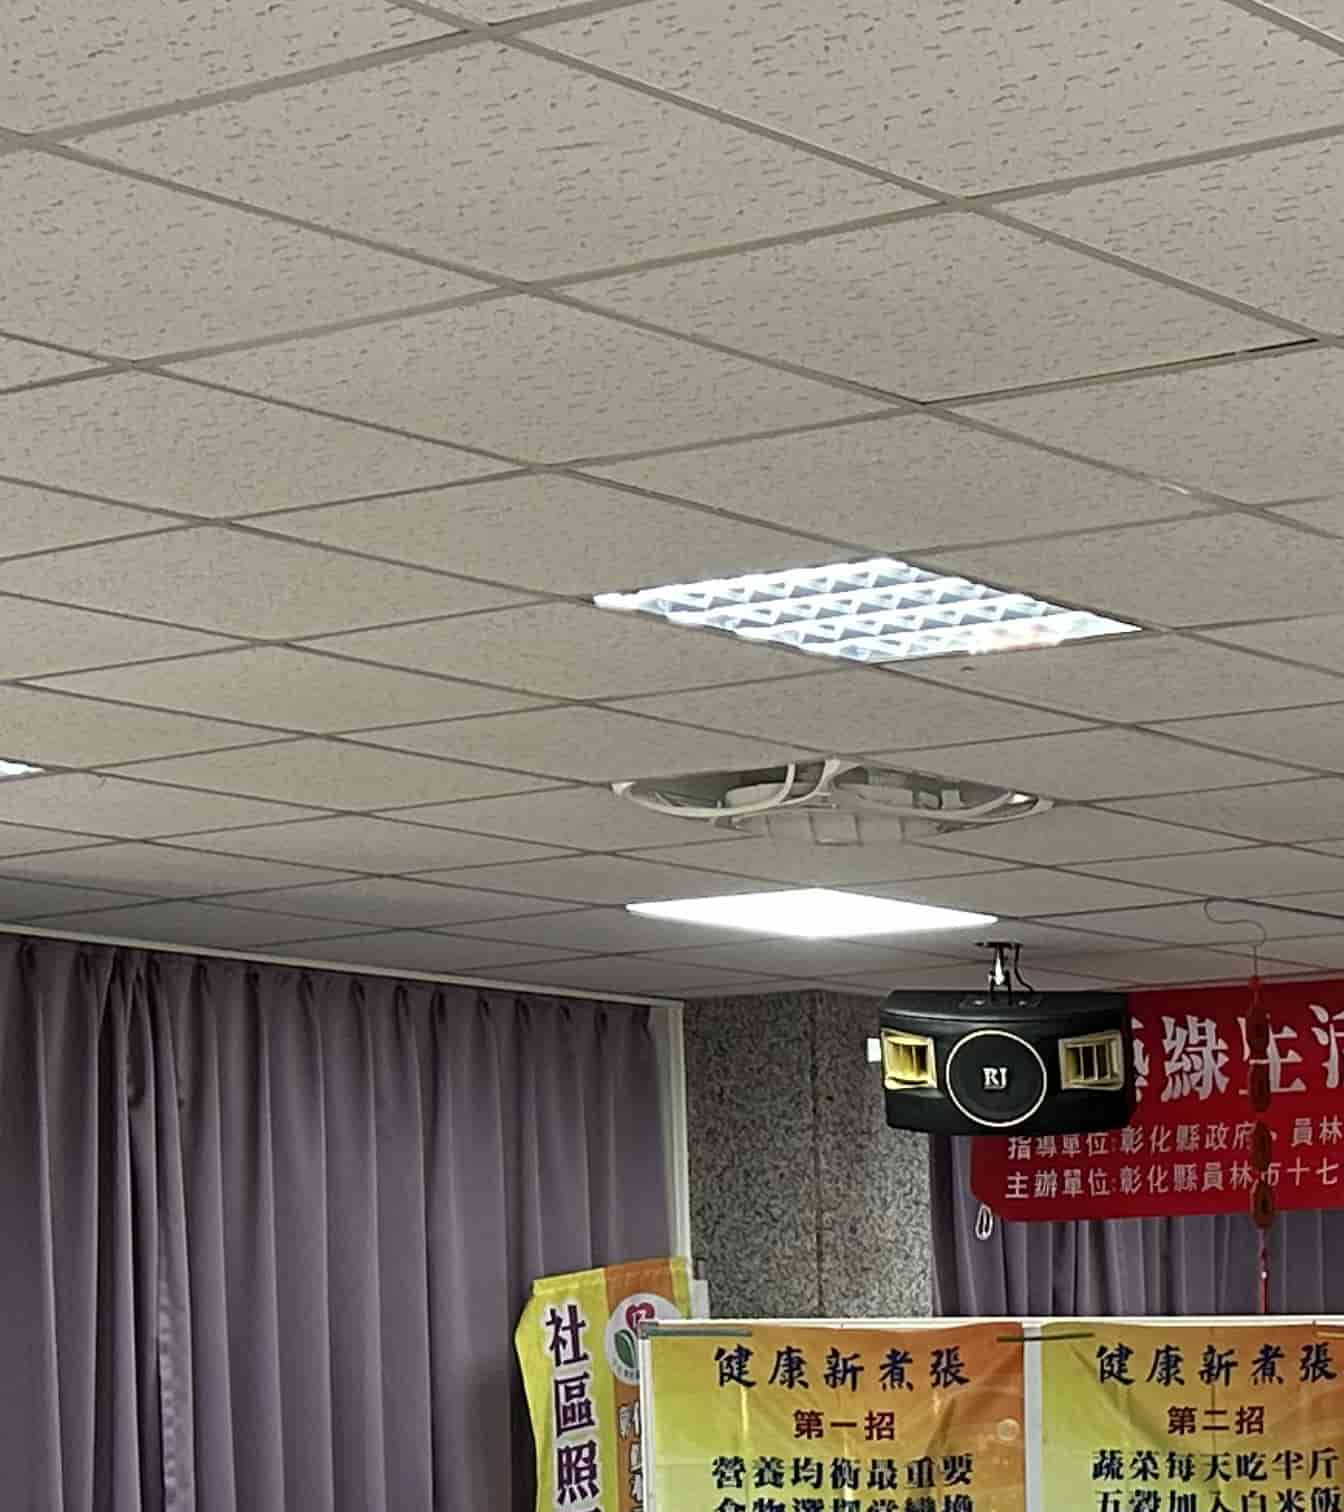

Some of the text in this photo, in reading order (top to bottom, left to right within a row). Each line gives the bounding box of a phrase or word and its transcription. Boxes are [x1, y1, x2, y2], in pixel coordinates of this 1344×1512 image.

[713, 1343, 971, 1393] 健康新煮張
[1096, 1342, 1338, 1387] 健康新煮張
[793, 1409, 896, 1441] 第一招
[1167, 1406, 1266, 1436] 第二招
[712, 1453, 973, 1490] 營養均衡最重要
[1091, 1447, 1341, 1483] 蔬菜每天吃半斤
